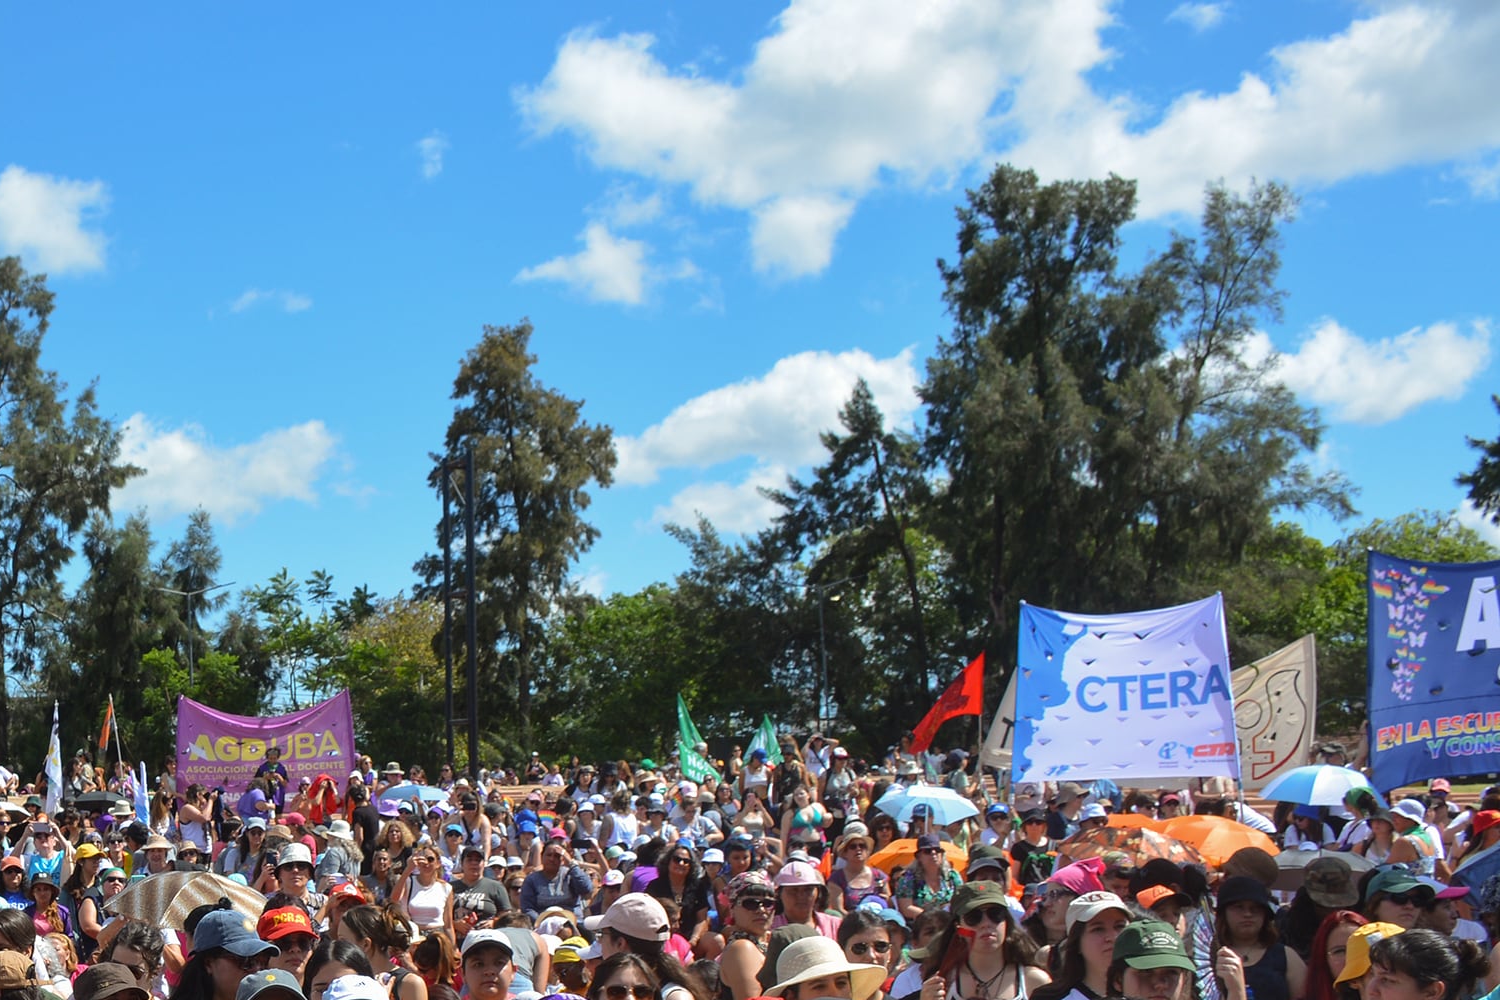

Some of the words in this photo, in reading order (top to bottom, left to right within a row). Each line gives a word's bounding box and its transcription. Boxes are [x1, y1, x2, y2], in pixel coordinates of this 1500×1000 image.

[1075, 664, 1232, 713] CTERA
[1376, 723, 1403, 752] EN
[1405, 719, 1433, 744] LA
[1426, 738, 1445, 760] Y
[185, 765, 249, 774] ASOCIACION
[298, 761, 345, 771] DOCENTE
